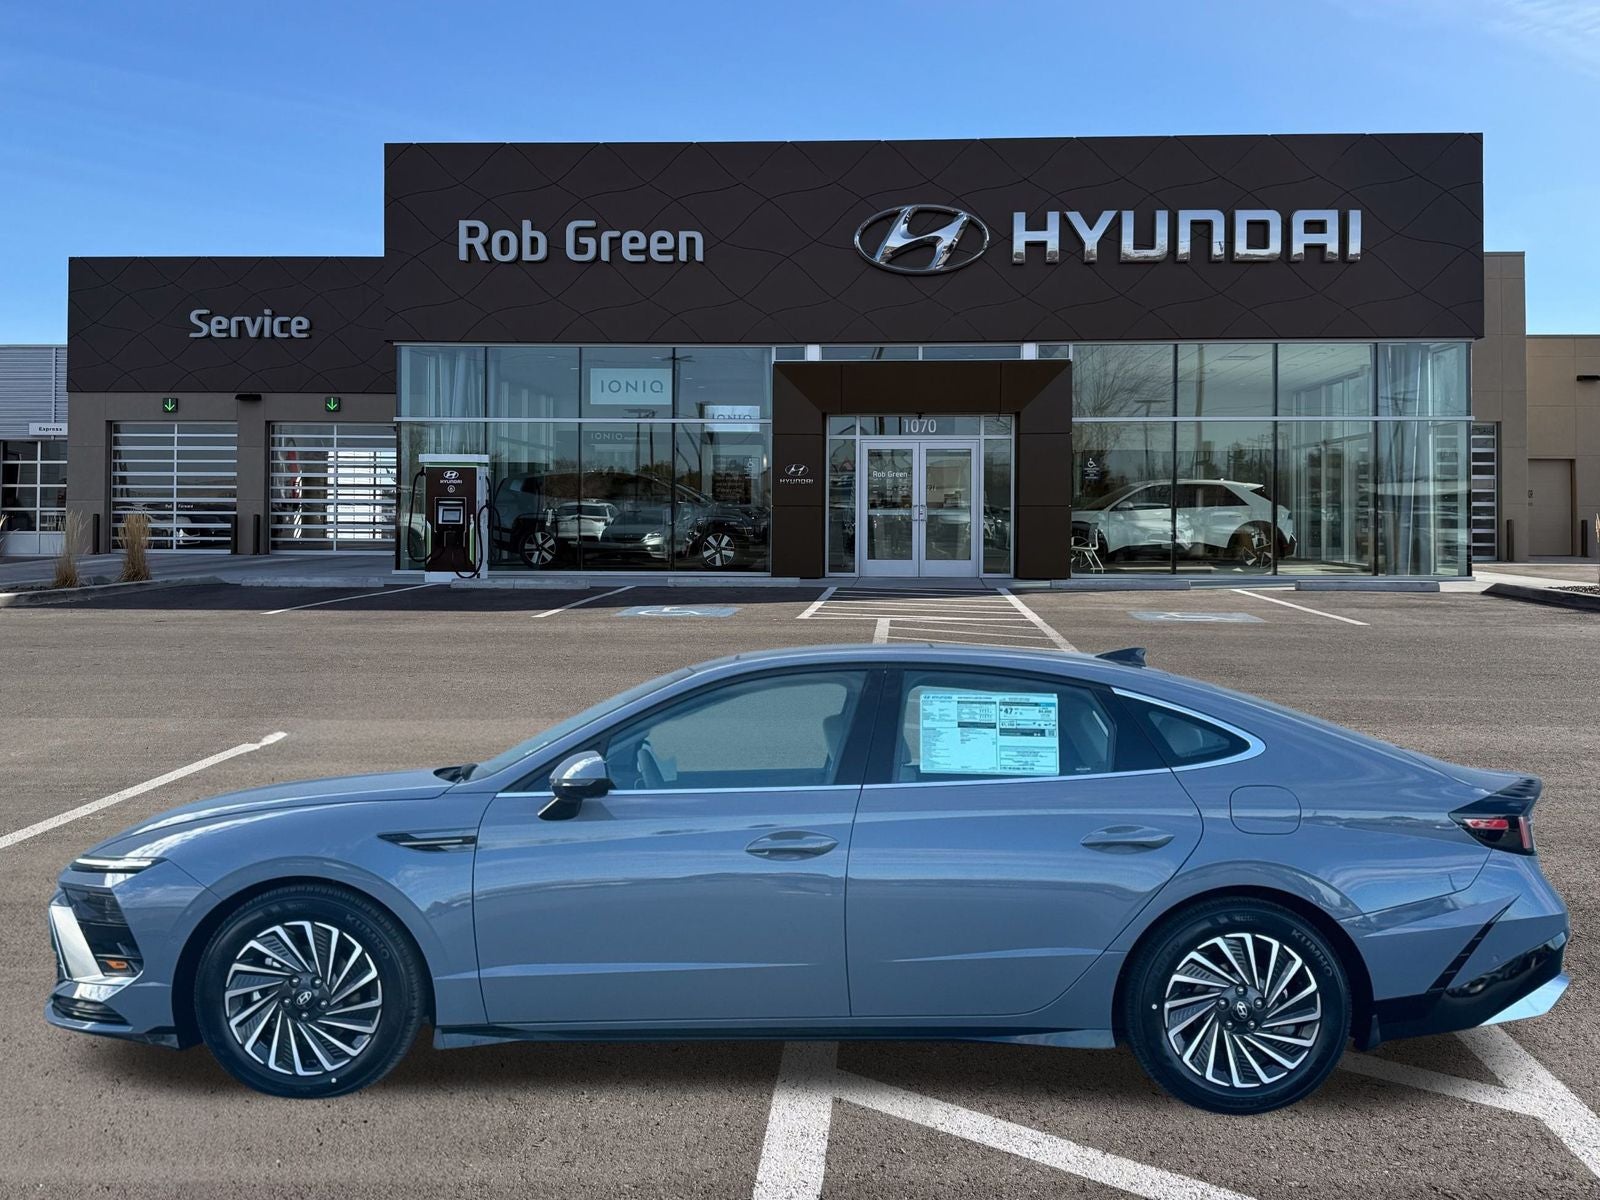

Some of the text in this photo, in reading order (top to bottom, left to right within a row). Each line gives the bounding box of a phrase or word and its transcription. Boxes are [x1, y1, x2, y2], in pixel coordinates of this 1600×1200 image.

[458, 219, 705, 263] Rob Green
[1012, 209, 1362, 264] HYUNDAI
[189, 308, 311, 339] Service
[600, 380, 664, 394] IONIQ
[590, 432, 623, 441] IONIQ
[904, 419, 937, 433] 1070
[345, 913, 390, 960] KUMHO
[1291, 928, 1333, 977] KUMHO
